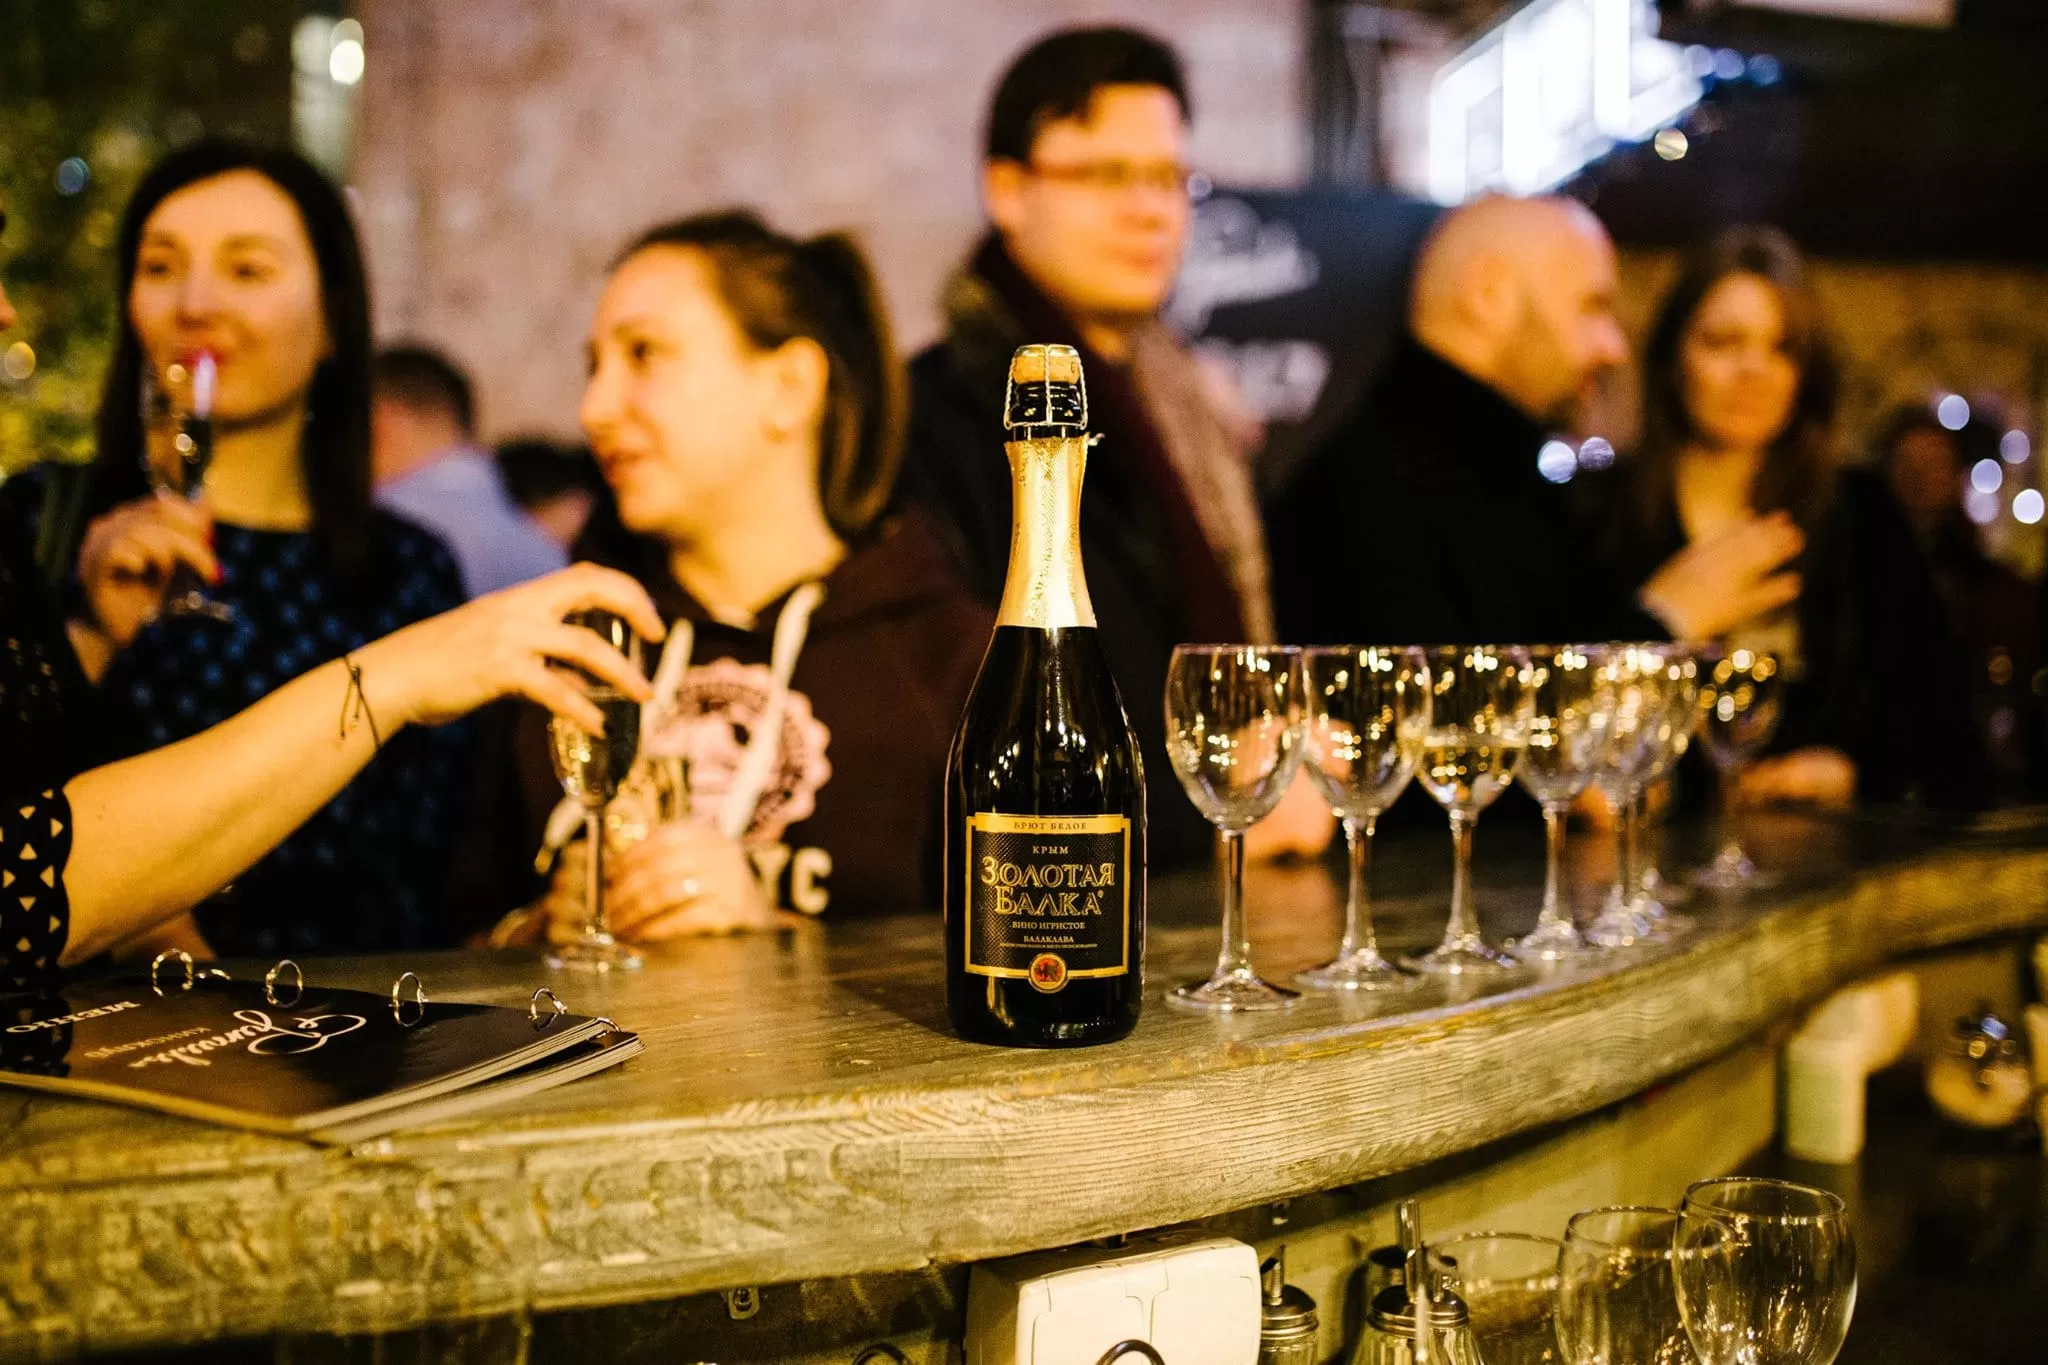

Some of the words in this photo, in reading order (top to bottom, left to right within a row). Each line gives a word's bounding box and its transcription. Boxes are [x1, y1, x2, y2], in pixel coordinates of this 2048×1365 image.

[1014, 822, 1045, 831] БРЮТ
[1050, 823, 1088, 831] БЕЛОЕ
[1032, 845, 1069, 855] КРЫМ
[1012, 920, 1038, 931] ВИНО
[1023, 935, 1075, 943] БАЛАКЛАВА
